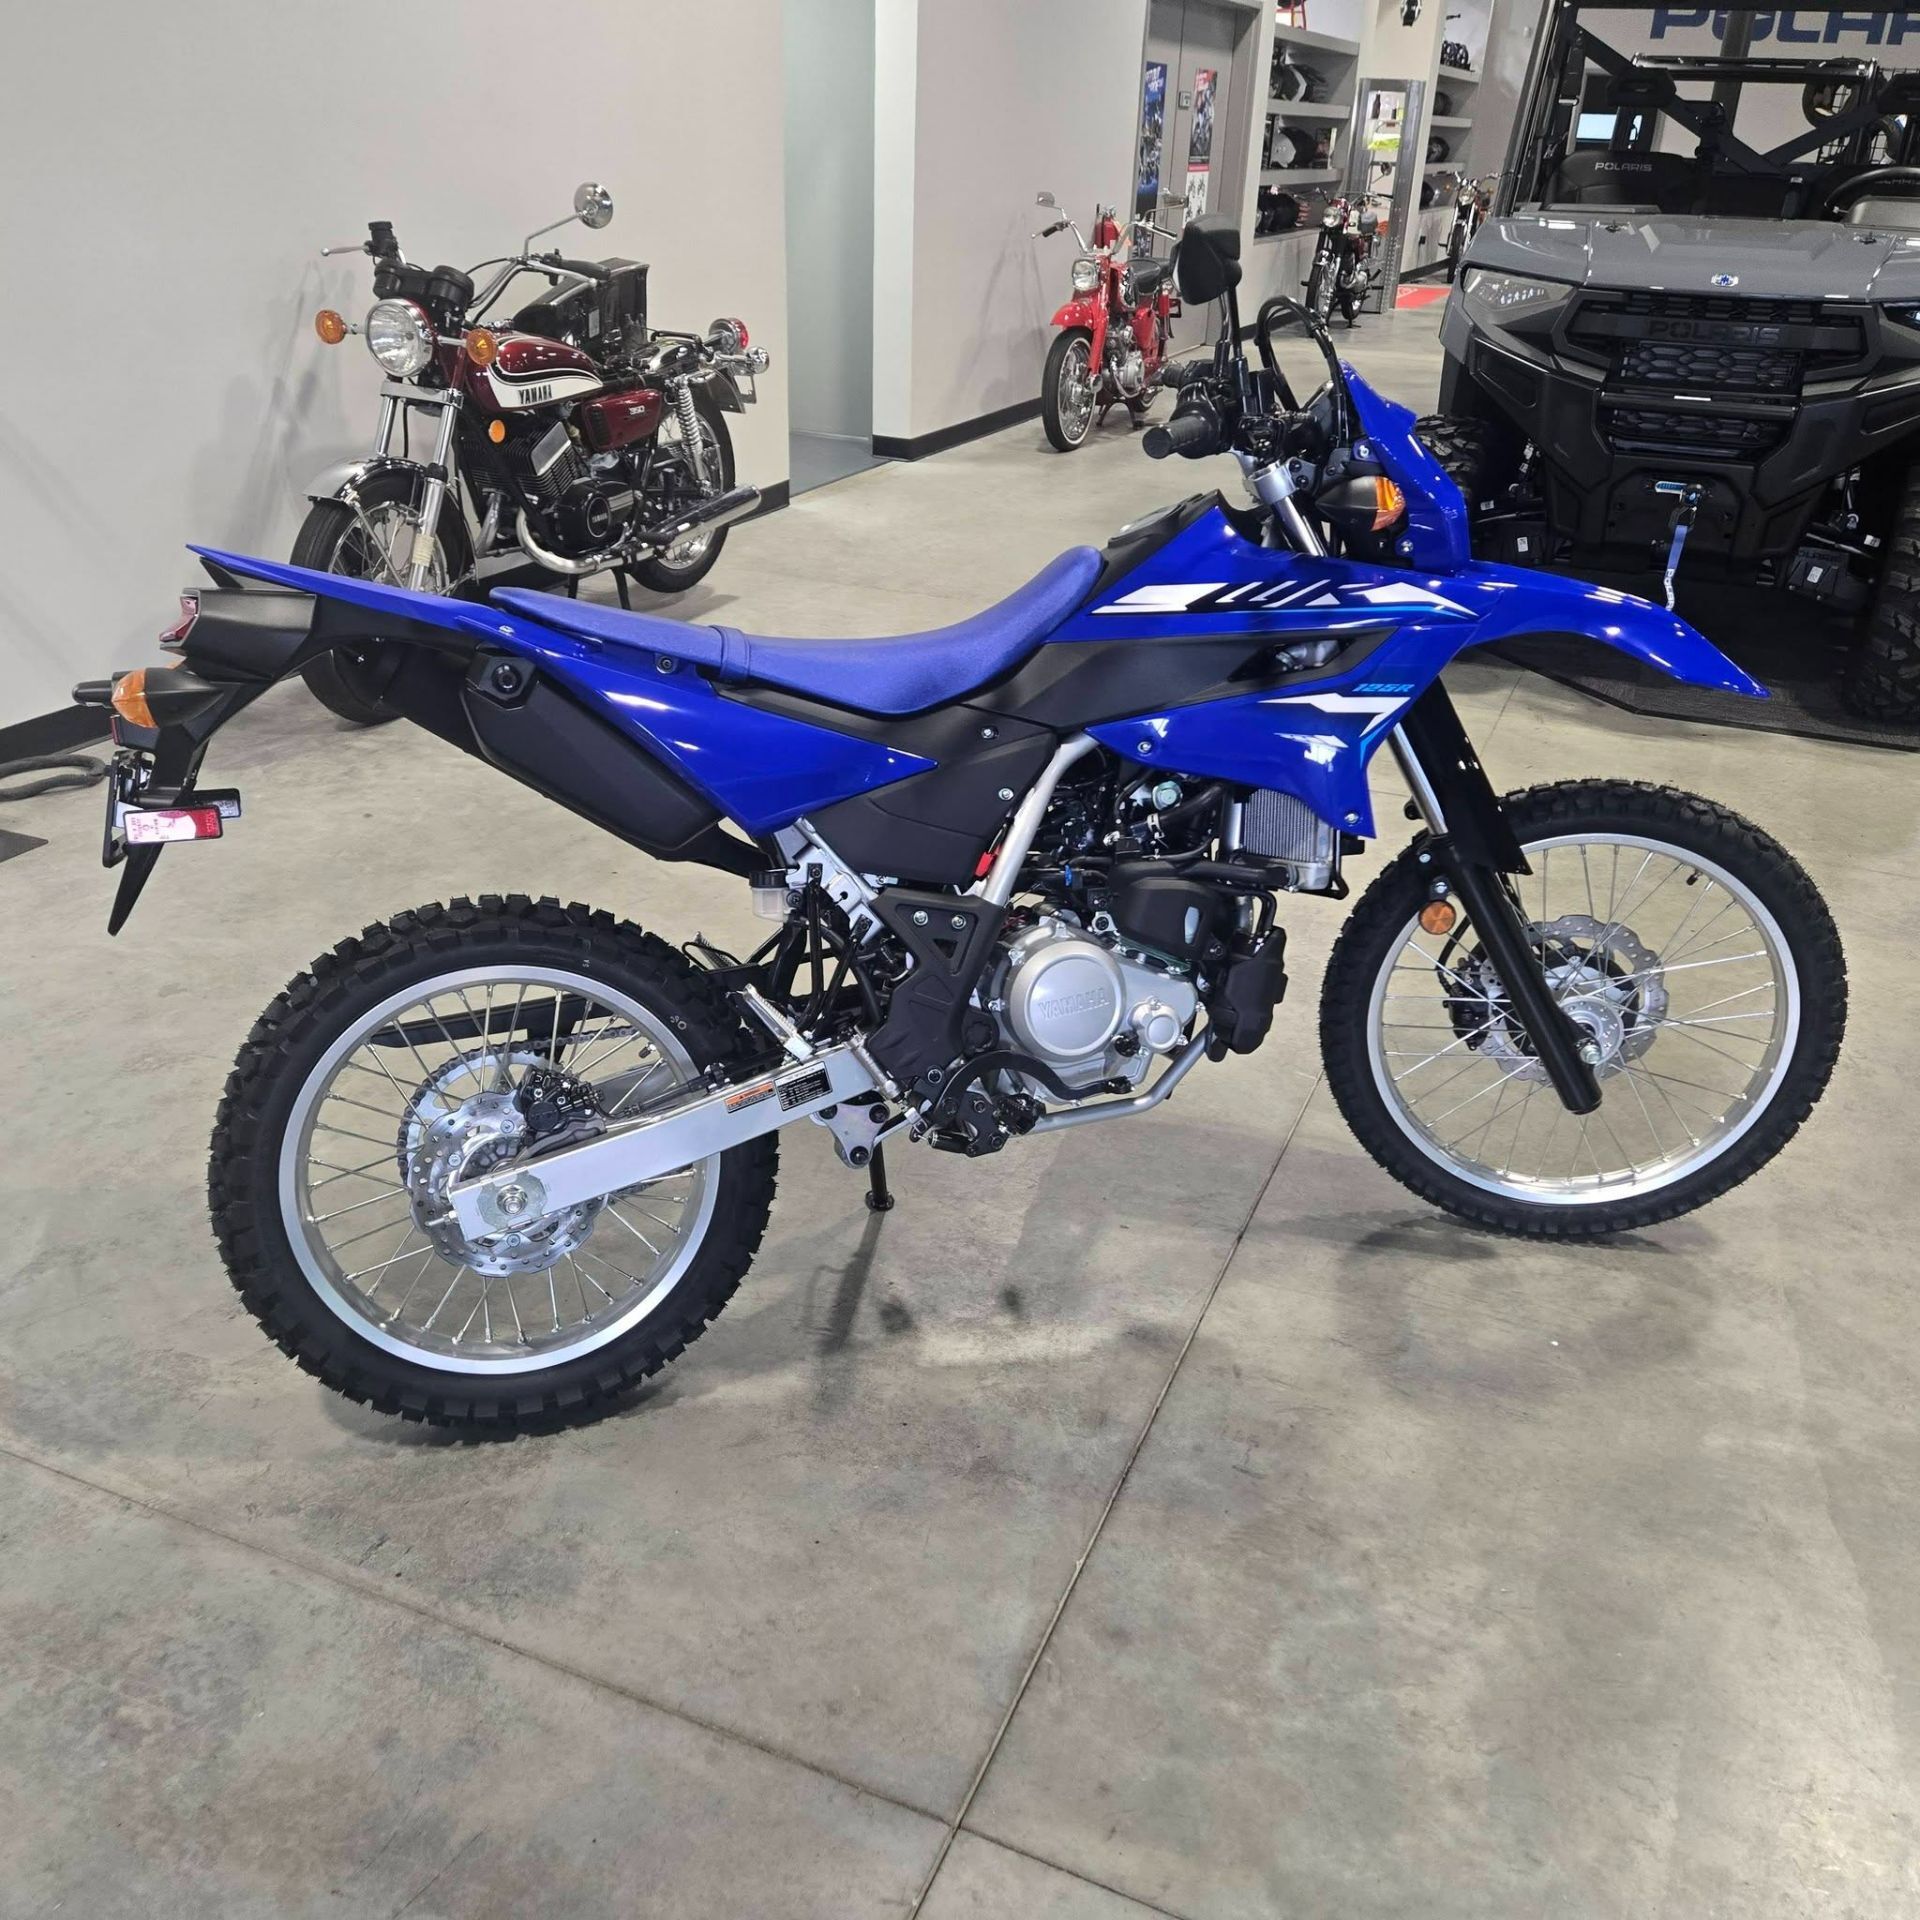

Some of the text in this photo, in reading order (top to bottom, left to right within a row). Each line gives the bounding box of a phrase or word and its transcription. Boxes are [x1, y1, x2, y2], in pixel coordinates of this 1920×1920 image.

[1594, 162, 1653, 172] POLARIS
[518, 384, 552, 404] YAMAHA
[1664, 568, 1675, 611] POLAR
[1352, 683, 1415, 693] 125R
[1038, 986, 1108, 1020] YAMAHA
